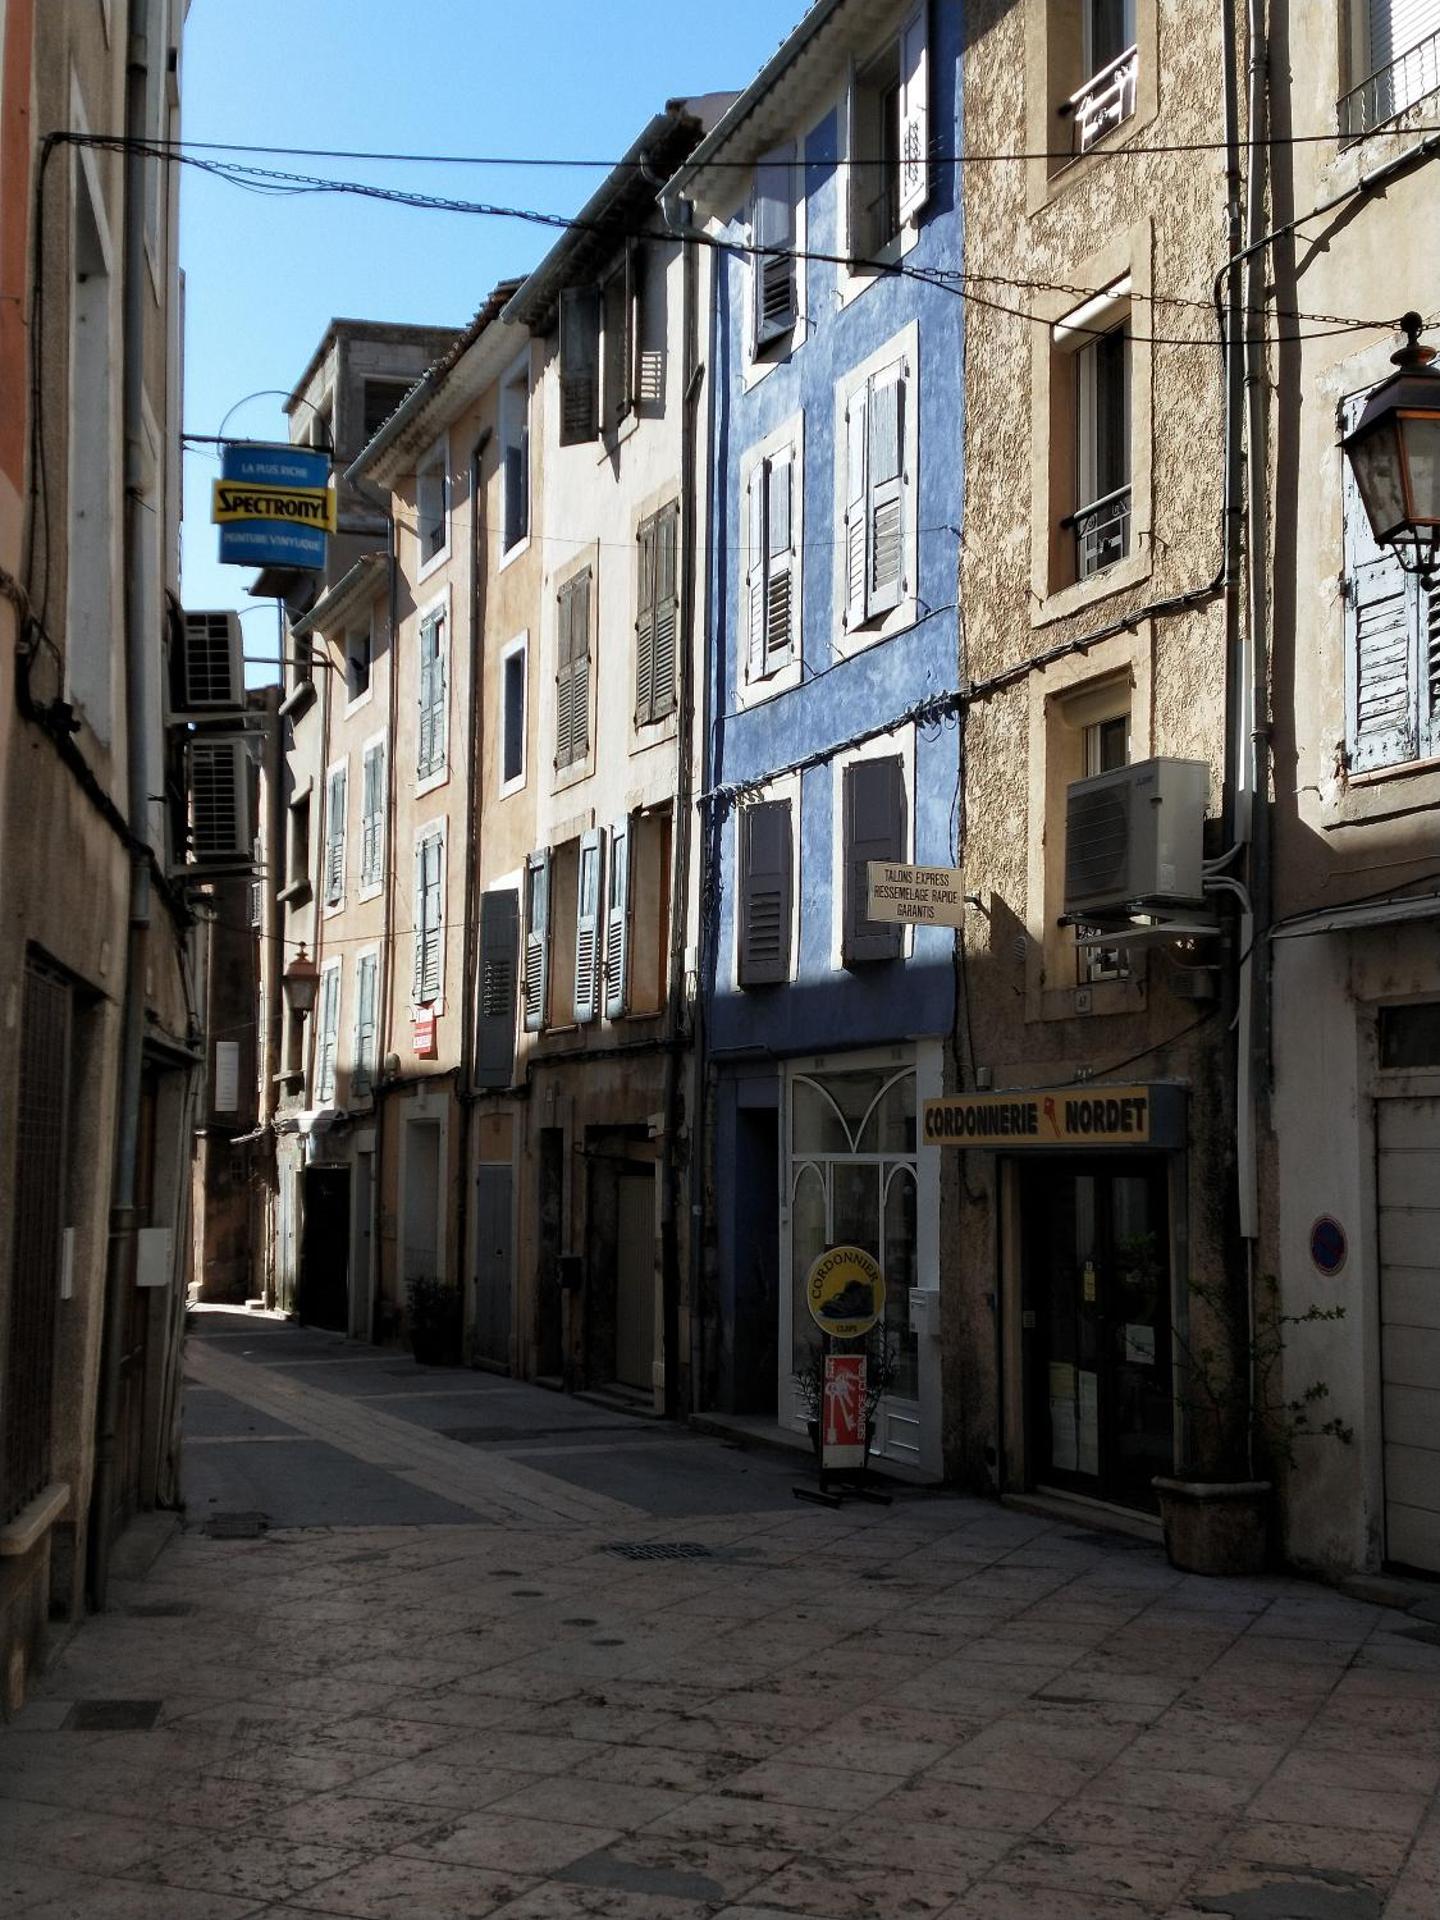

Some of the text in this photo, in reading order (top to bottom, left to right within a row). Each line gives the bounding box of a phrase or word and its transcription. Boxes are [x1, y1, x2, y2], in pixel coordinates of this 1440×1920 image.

[241, 463, 254, 473] LA
[256, 463, 279, 475] PLUS
[884, 868, 950, 887] TALONS EXPRESS
[873, 885, 958, 904] RESSEMELAGE RAPIDE
[896, 903, 935, 919] GARANTIS
[924, 1097, 1146, 1138] CORDONNERIE NORDET
[812, 1252, 879, 1300] CORDONNIER
